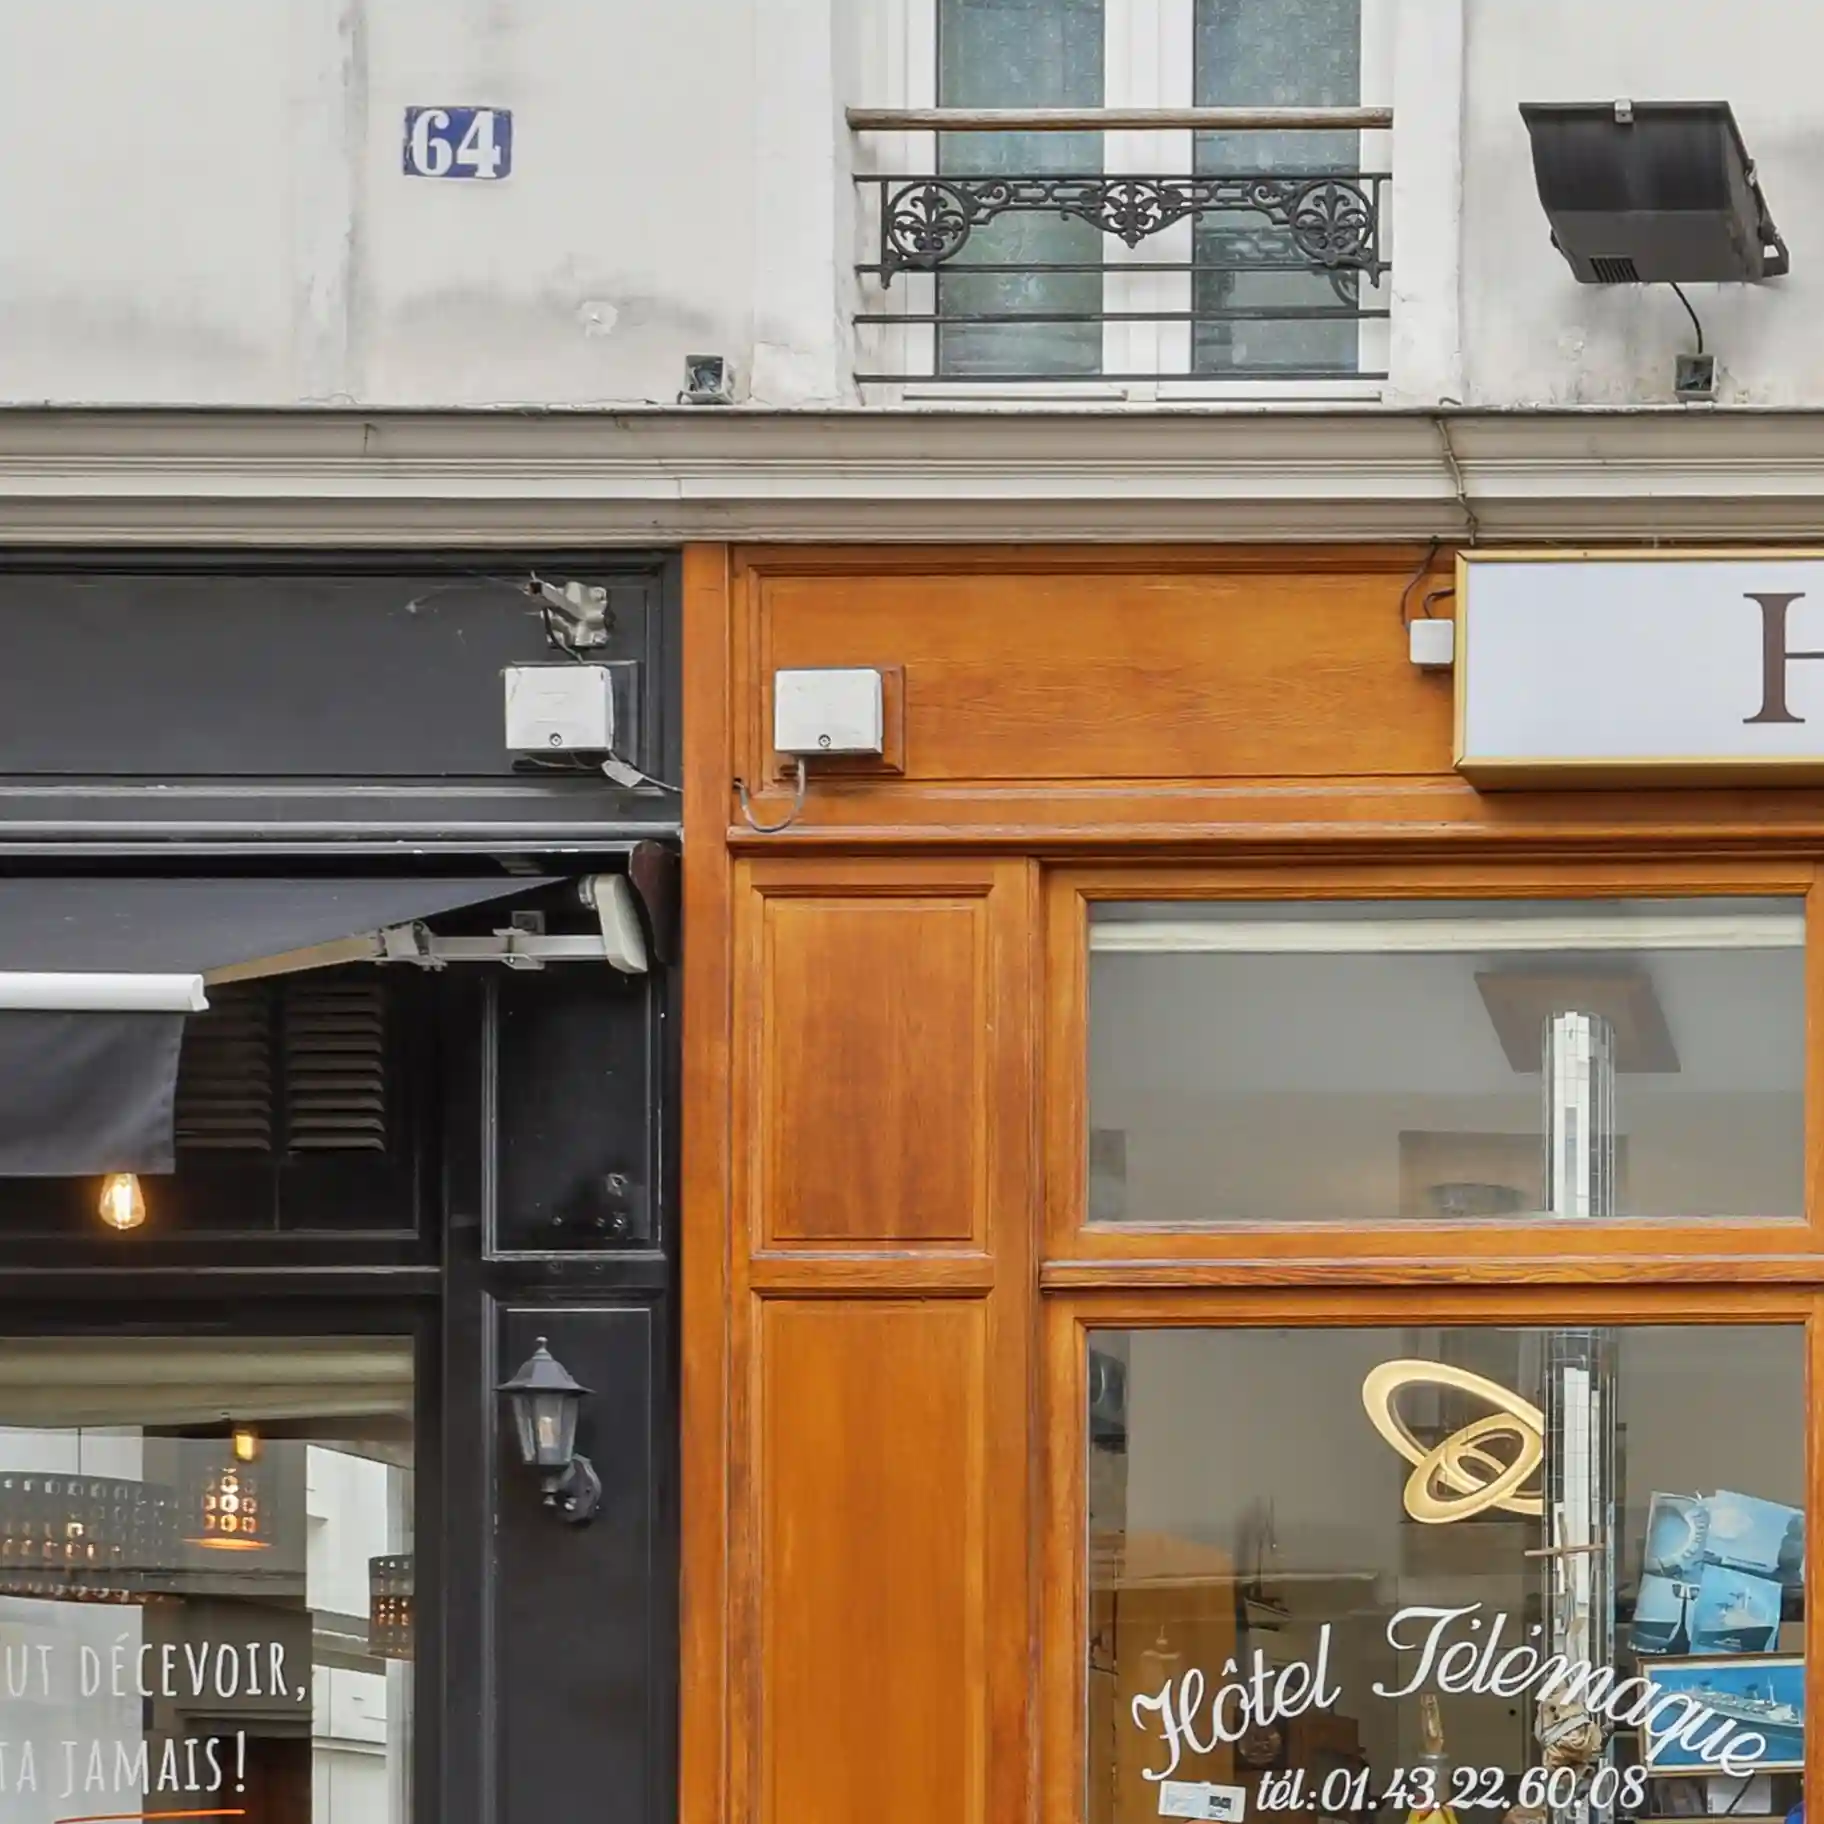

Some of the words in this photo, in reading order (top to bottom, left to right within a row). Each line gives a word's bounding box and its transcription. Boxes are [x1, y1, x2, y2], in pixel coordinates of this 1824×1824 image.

[411, 109, 502, 178] 64
[79, 1632, 307, 1702] DÉCEVOIR,
[1131, 1622, 1342, 1781] Hôtel
[1371, 1602, 1767, 1779] Télémaque
